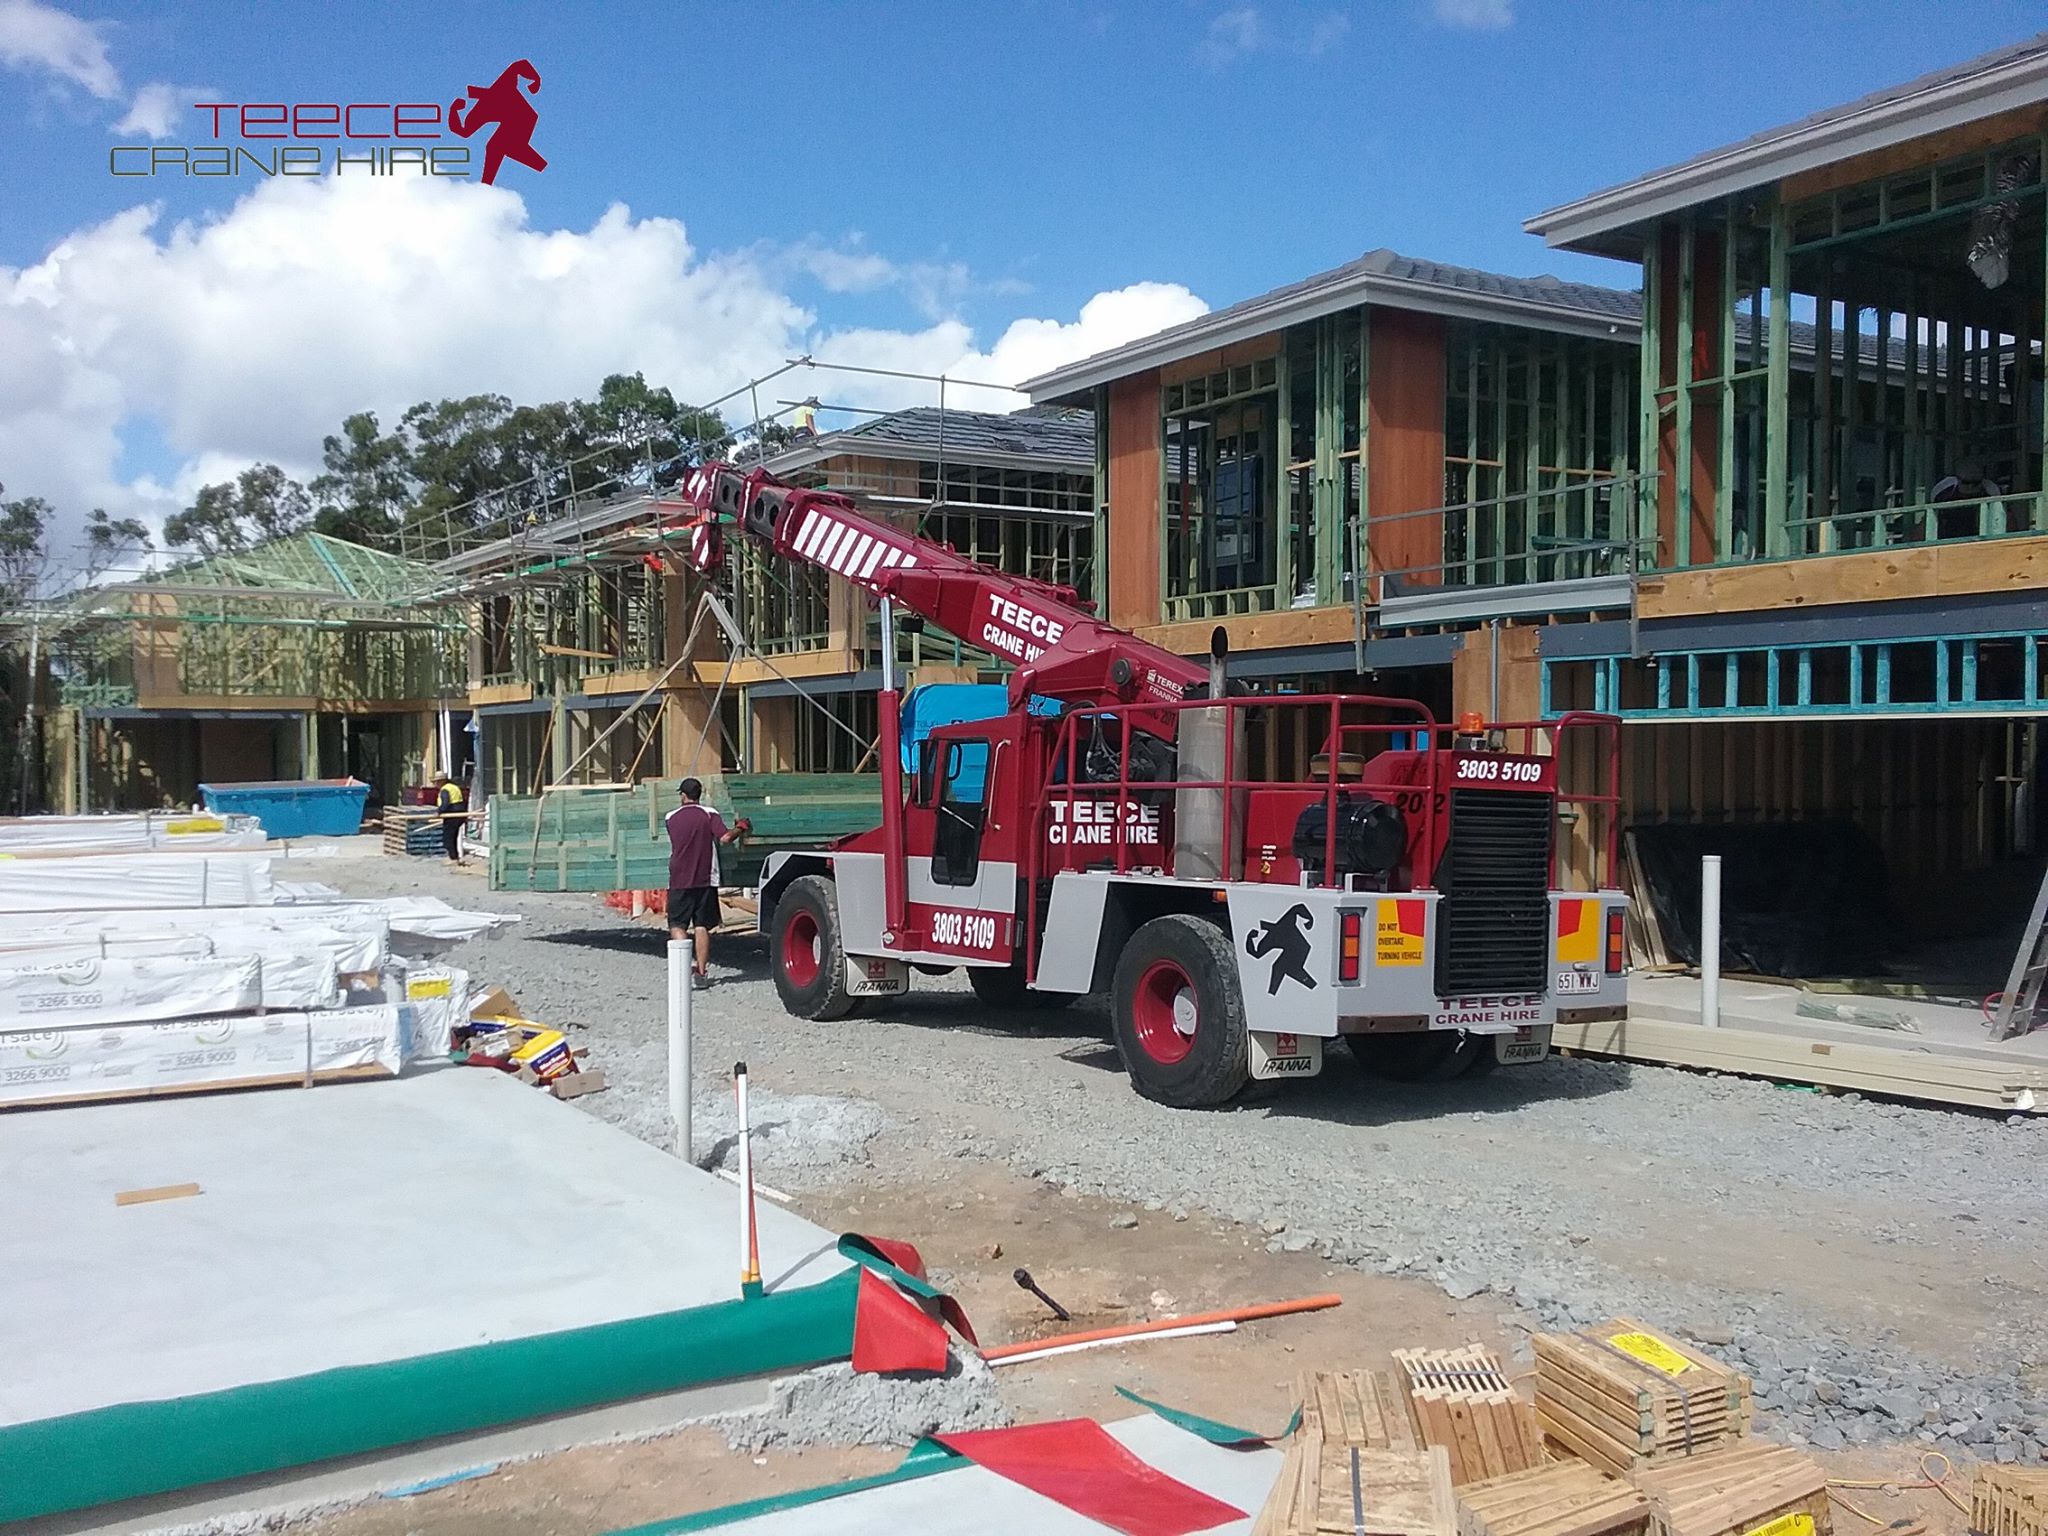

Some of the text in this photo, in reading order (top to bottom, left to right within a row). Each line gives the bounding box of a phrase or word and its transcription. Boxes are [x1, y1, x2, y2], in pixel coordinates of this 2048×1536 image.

[989, 593, 1064, 645] TEECE
[983, 622, 1046, 663] CRANE HI
[1156, 674, 1184, 695] TEREX
[1148, 686, 1178, 703] FRANNA
[1457, 759, 1542, 782] 3803 5109
[1048, 800, 1161, 824] TEECE
[931, 911, 996, 950] 3803 5109
[853, 979, 899, 992] FRANNA
[1558, 973, 1574, 989] 651
[37, 995, 69, 1008] 3266
[71, 993, 103, 1006] 9000
[1437, 994, 1542, 1011] TEECE
[1435, 1009, 1540, 1024] CRANE HIRE
[6, 1065, 71, 1082] 3266 9000
[1260, 1056, 1312, 1074] FRANNA
